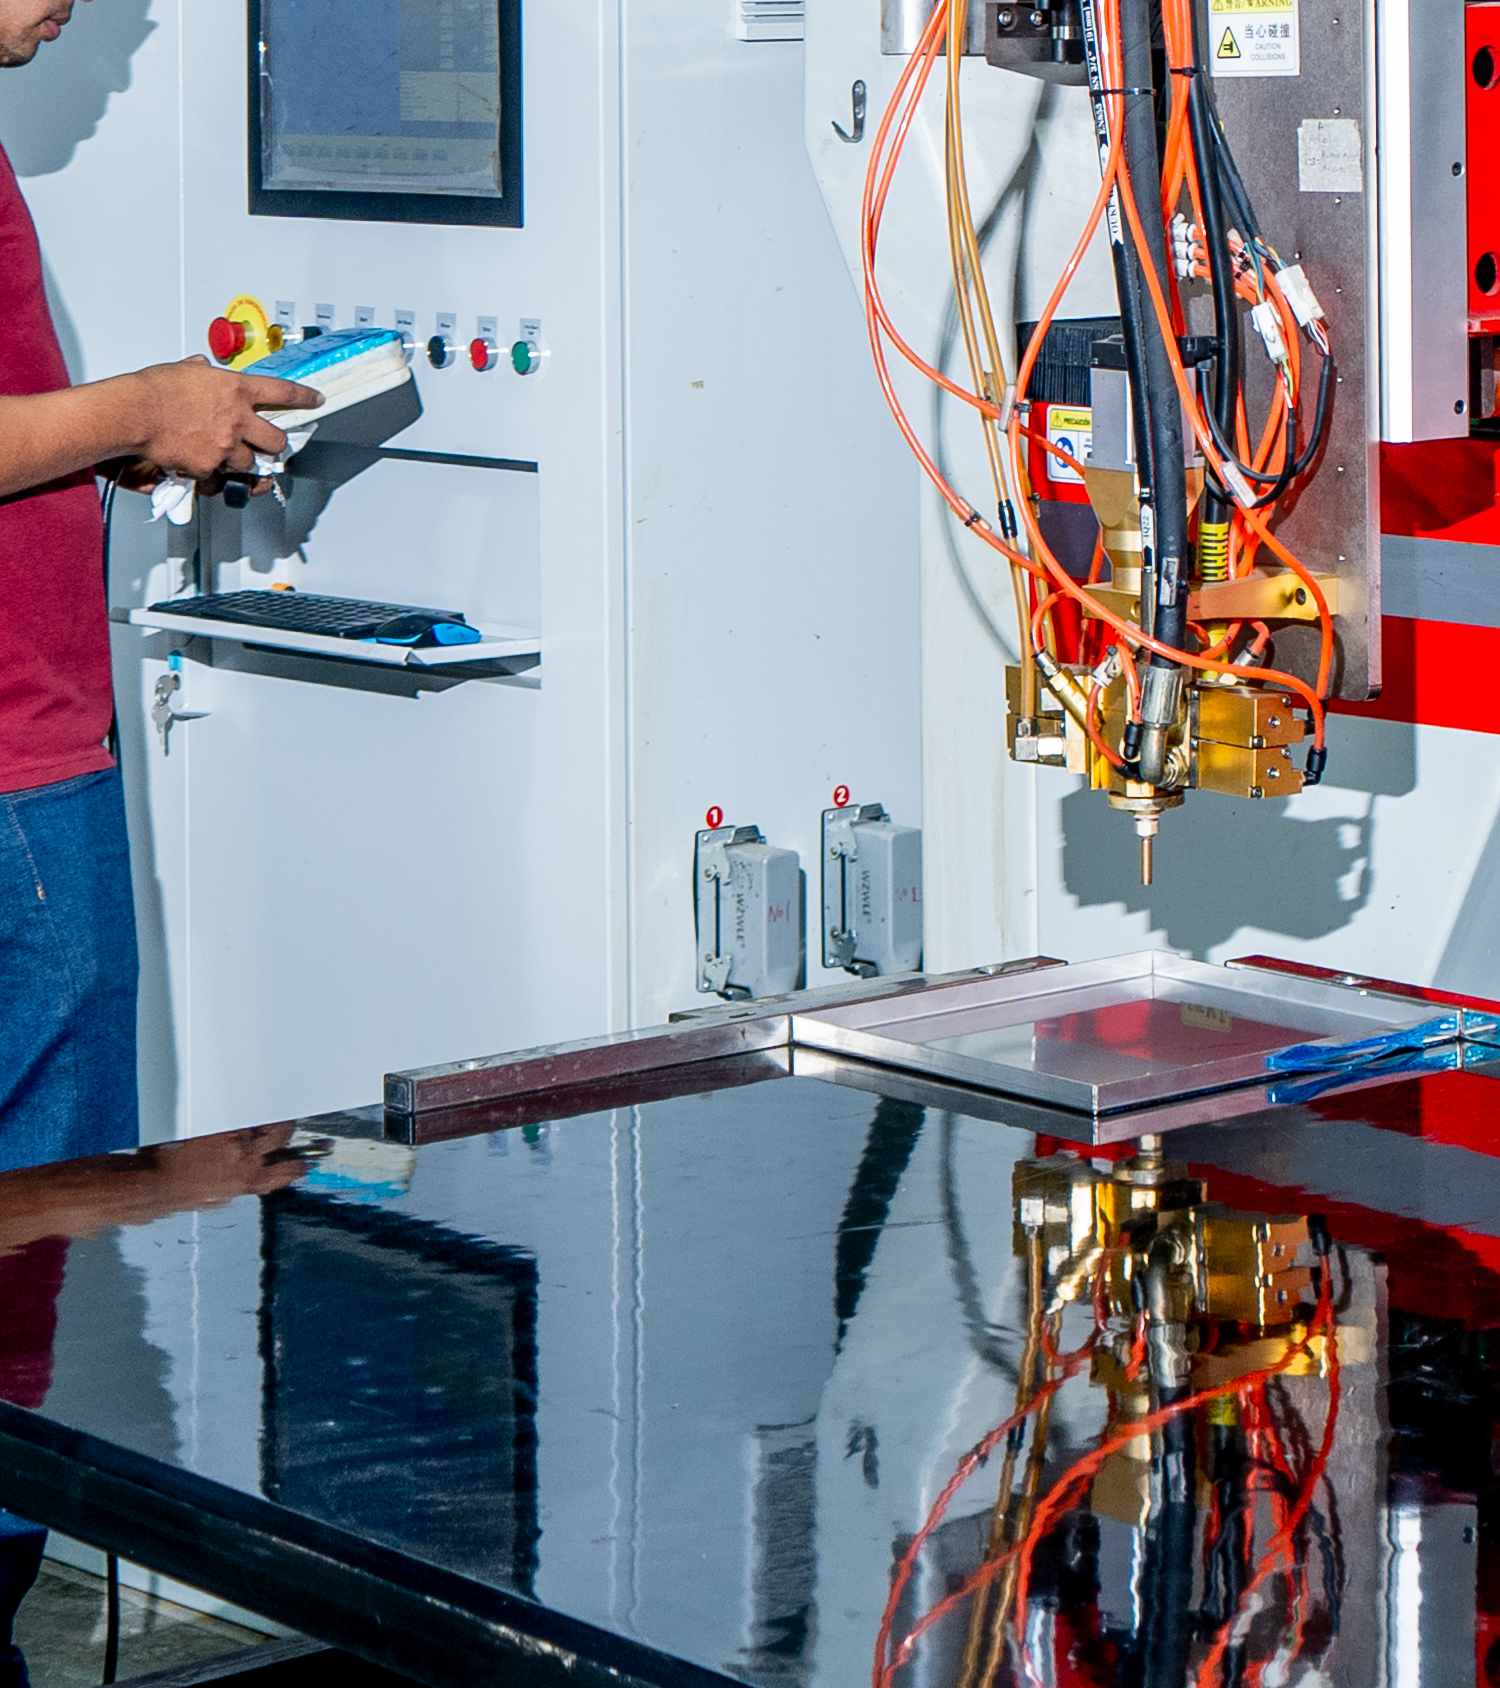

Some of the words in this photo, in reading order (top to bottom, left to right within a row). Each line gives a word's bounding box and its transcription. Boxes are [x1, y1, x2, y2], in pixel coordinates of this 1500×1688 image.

[1244, 23, 1290, 39] 当心碰撞
[1254, 42, 1281, 50] CAUTION
[1250, 53, 1285, 61] COLLISIONS
[837, 787, 847, 803] 2
